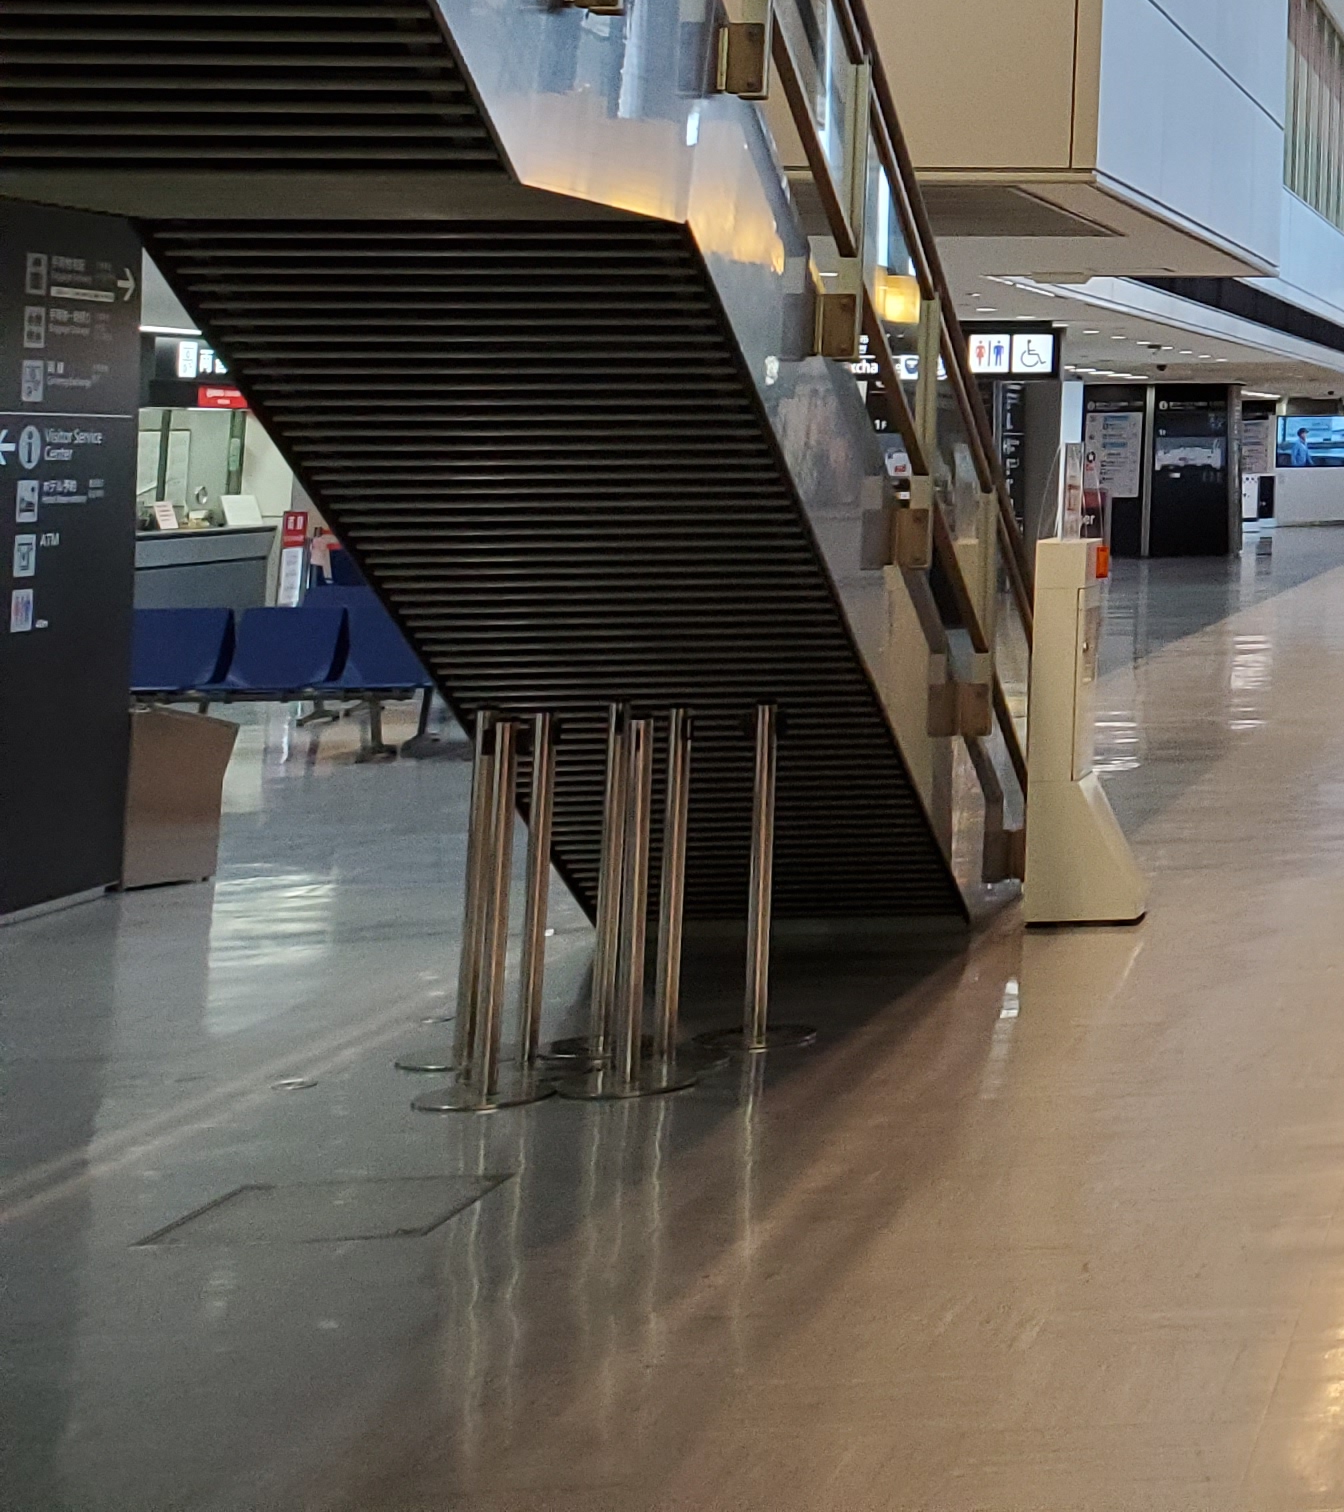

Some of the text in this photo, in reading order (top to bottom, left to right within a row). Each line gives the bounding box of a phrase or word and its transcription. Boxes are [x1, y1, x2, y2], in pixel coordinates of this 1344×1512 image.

[44, 427, 103, 445] Visitor Service
[44, 445, 73, 461] Center
